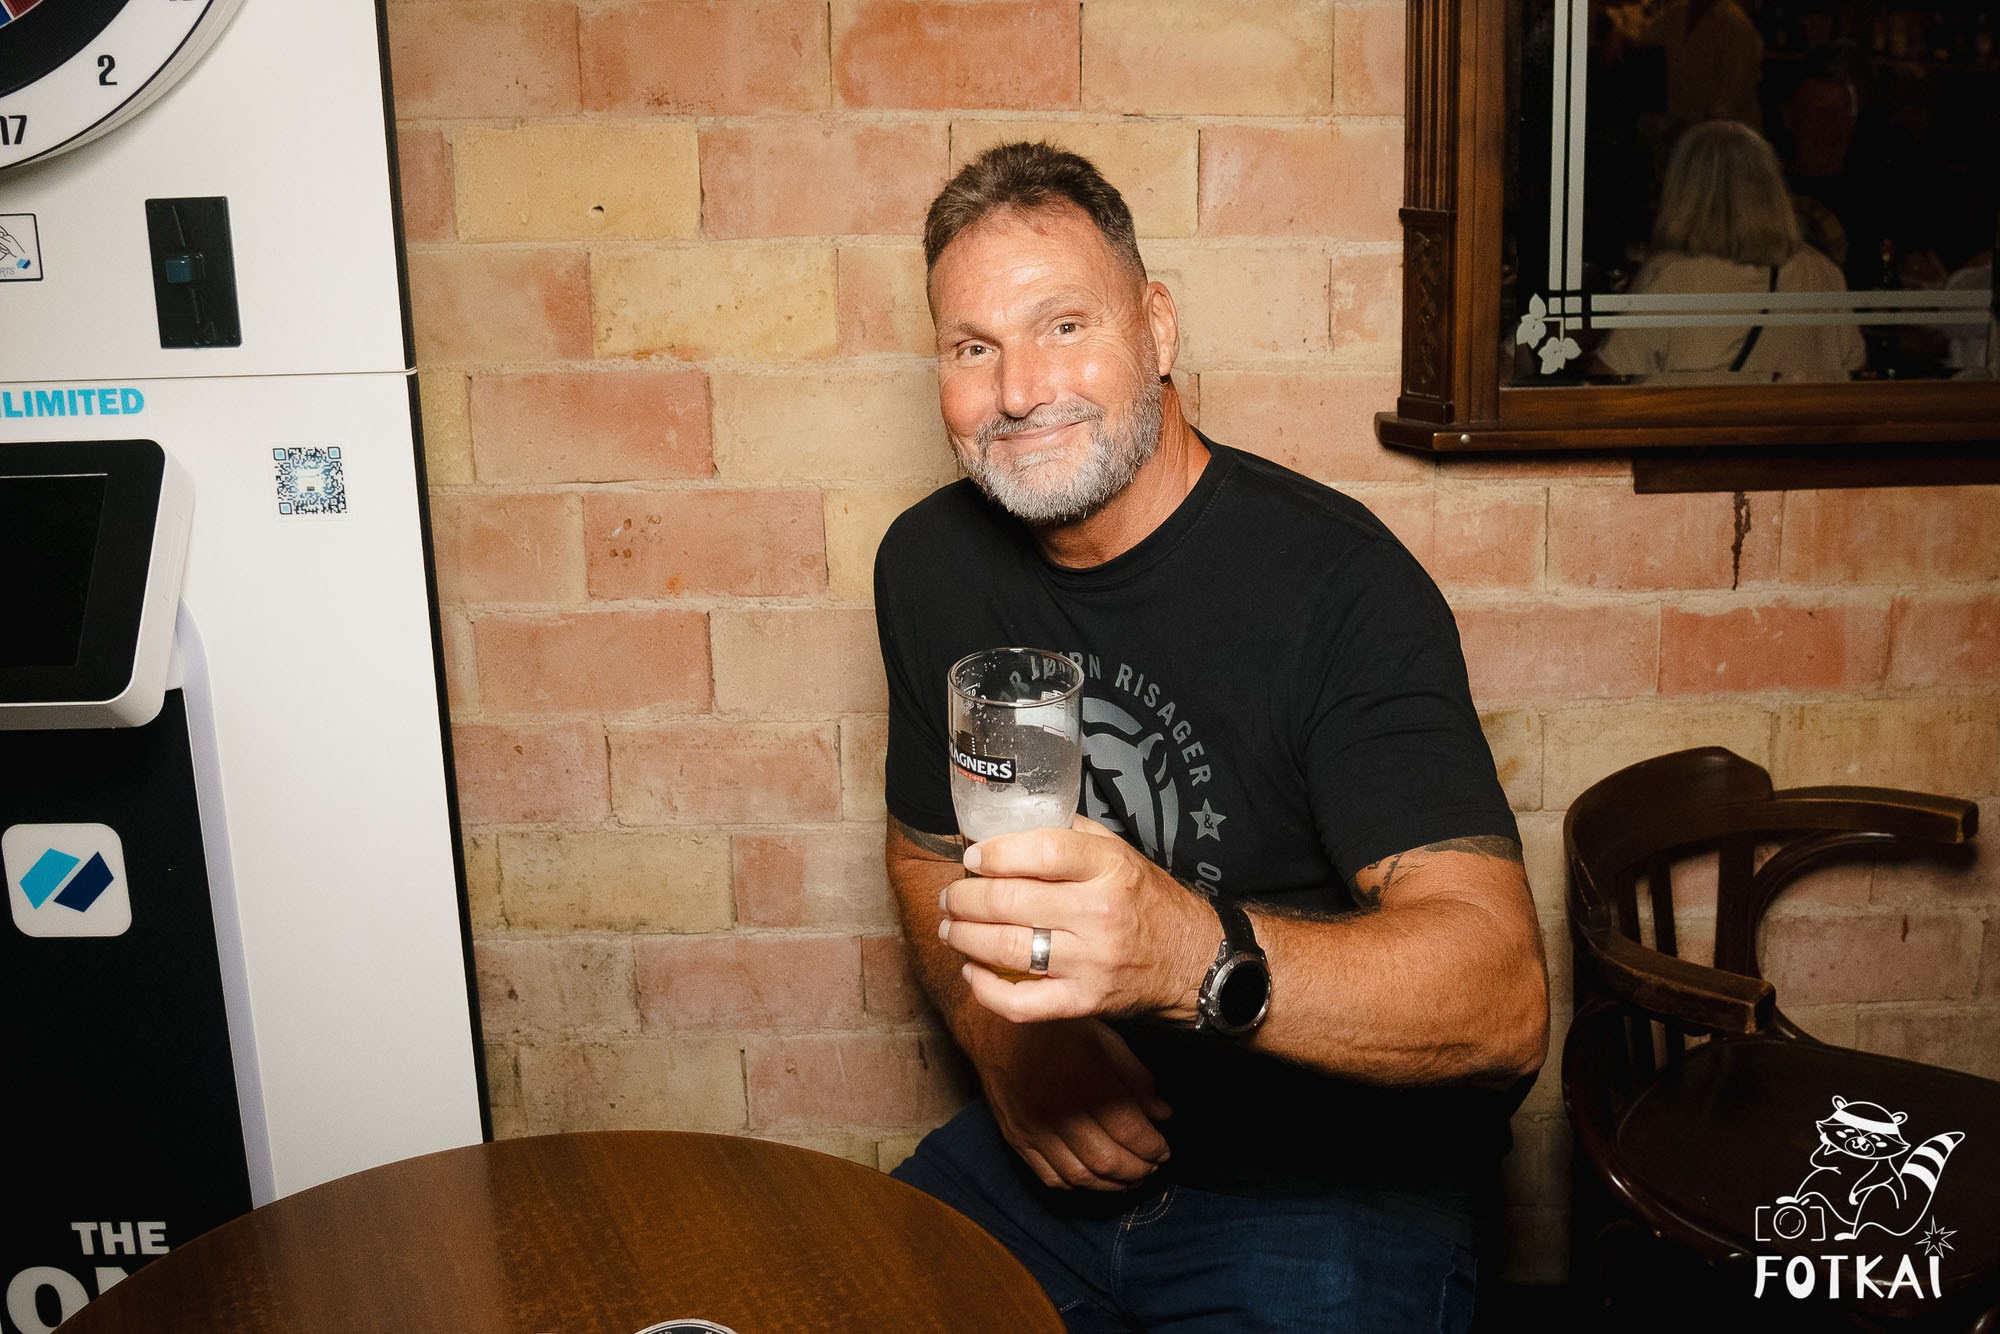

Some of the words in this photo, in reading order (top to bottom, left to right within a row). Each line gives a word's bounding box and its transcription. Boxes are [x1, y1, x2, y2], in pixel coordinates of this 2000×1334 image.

[97, 55, 117, 85] 2
[0, 115, 27, 145] 17
[0, 388, 145, 418] LIMITED
[1115, 663, 1212, 787] RISAGER
[71, 1221, 170, 1255] THE
